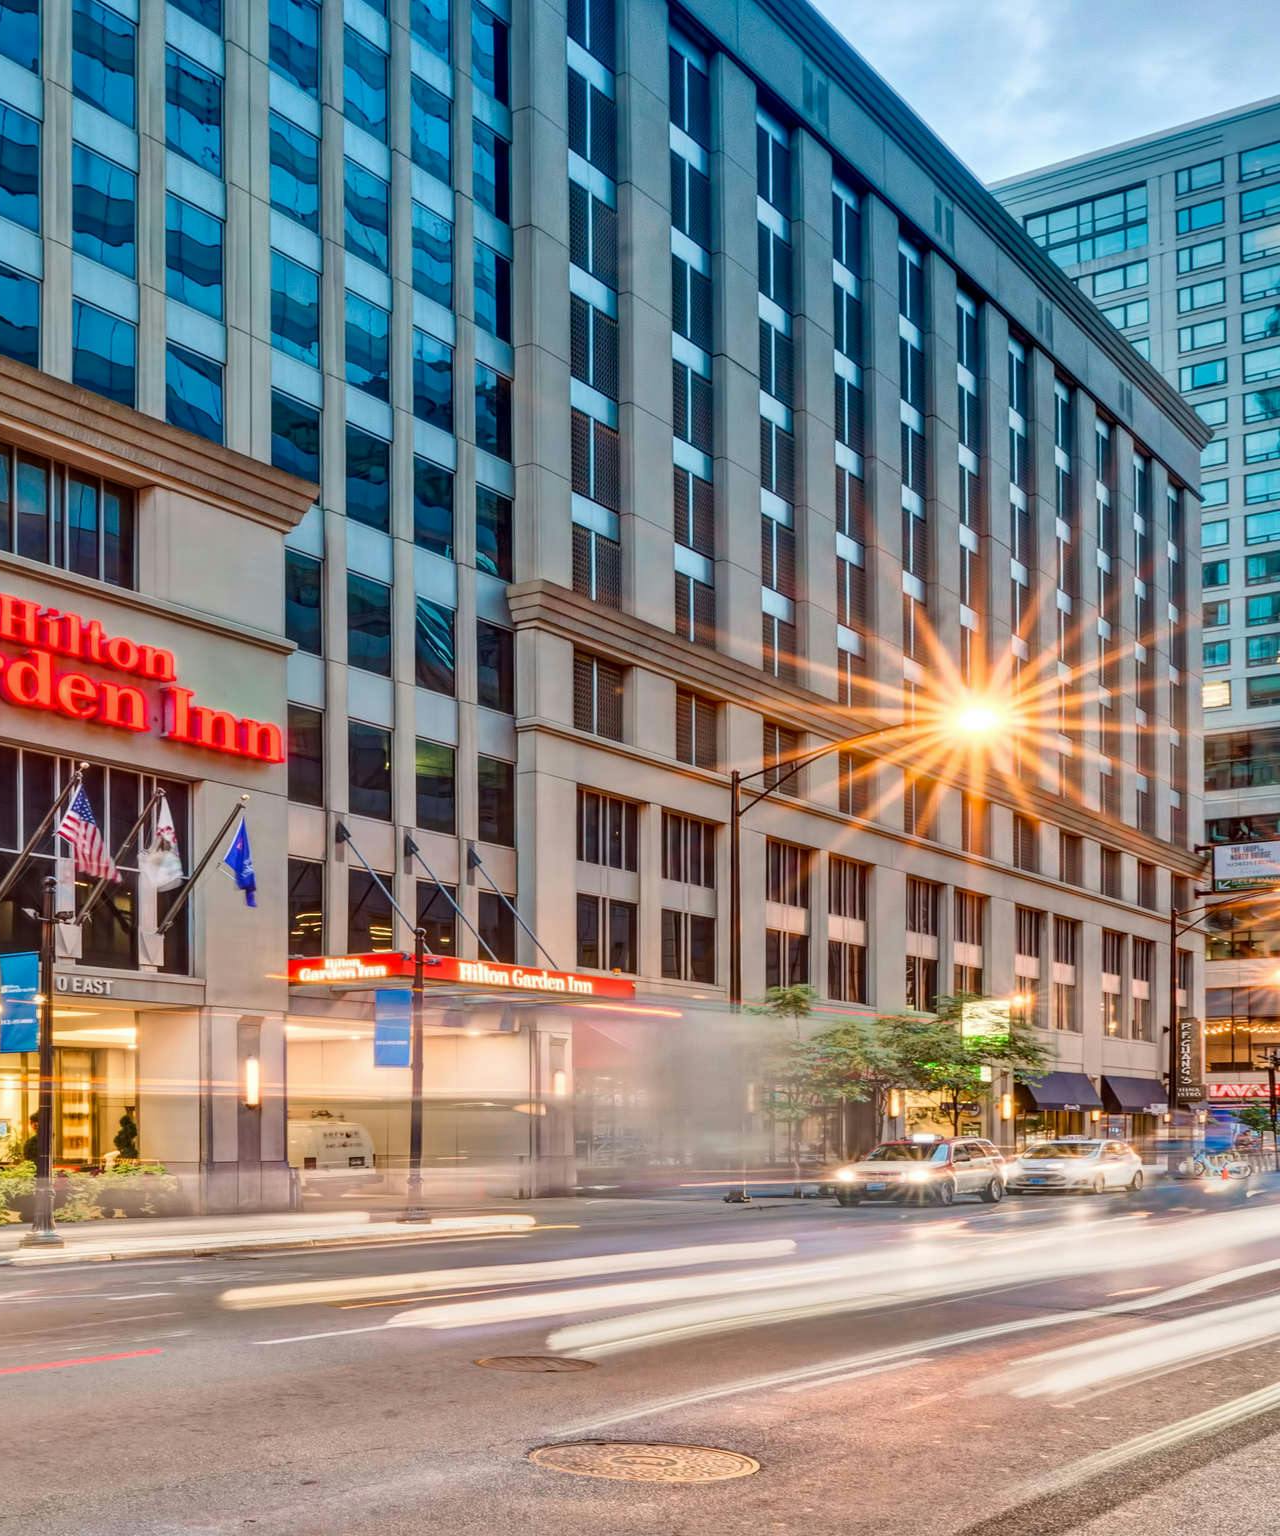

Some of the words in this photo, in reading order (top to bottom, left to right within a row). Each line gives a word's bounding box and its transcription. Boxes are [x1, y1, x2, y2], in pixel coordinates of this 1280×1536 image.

[161, 684, 285, 764] Inn
[299, 967, 357, 981] Garden
[357, 964, 387, 977] Inn
[459, 962, 509, 985] Hilton
[512, 969, 566, 992] Garden
[568, 976, 593, 993] Inn
[72, 978, 114, 994] EAST
